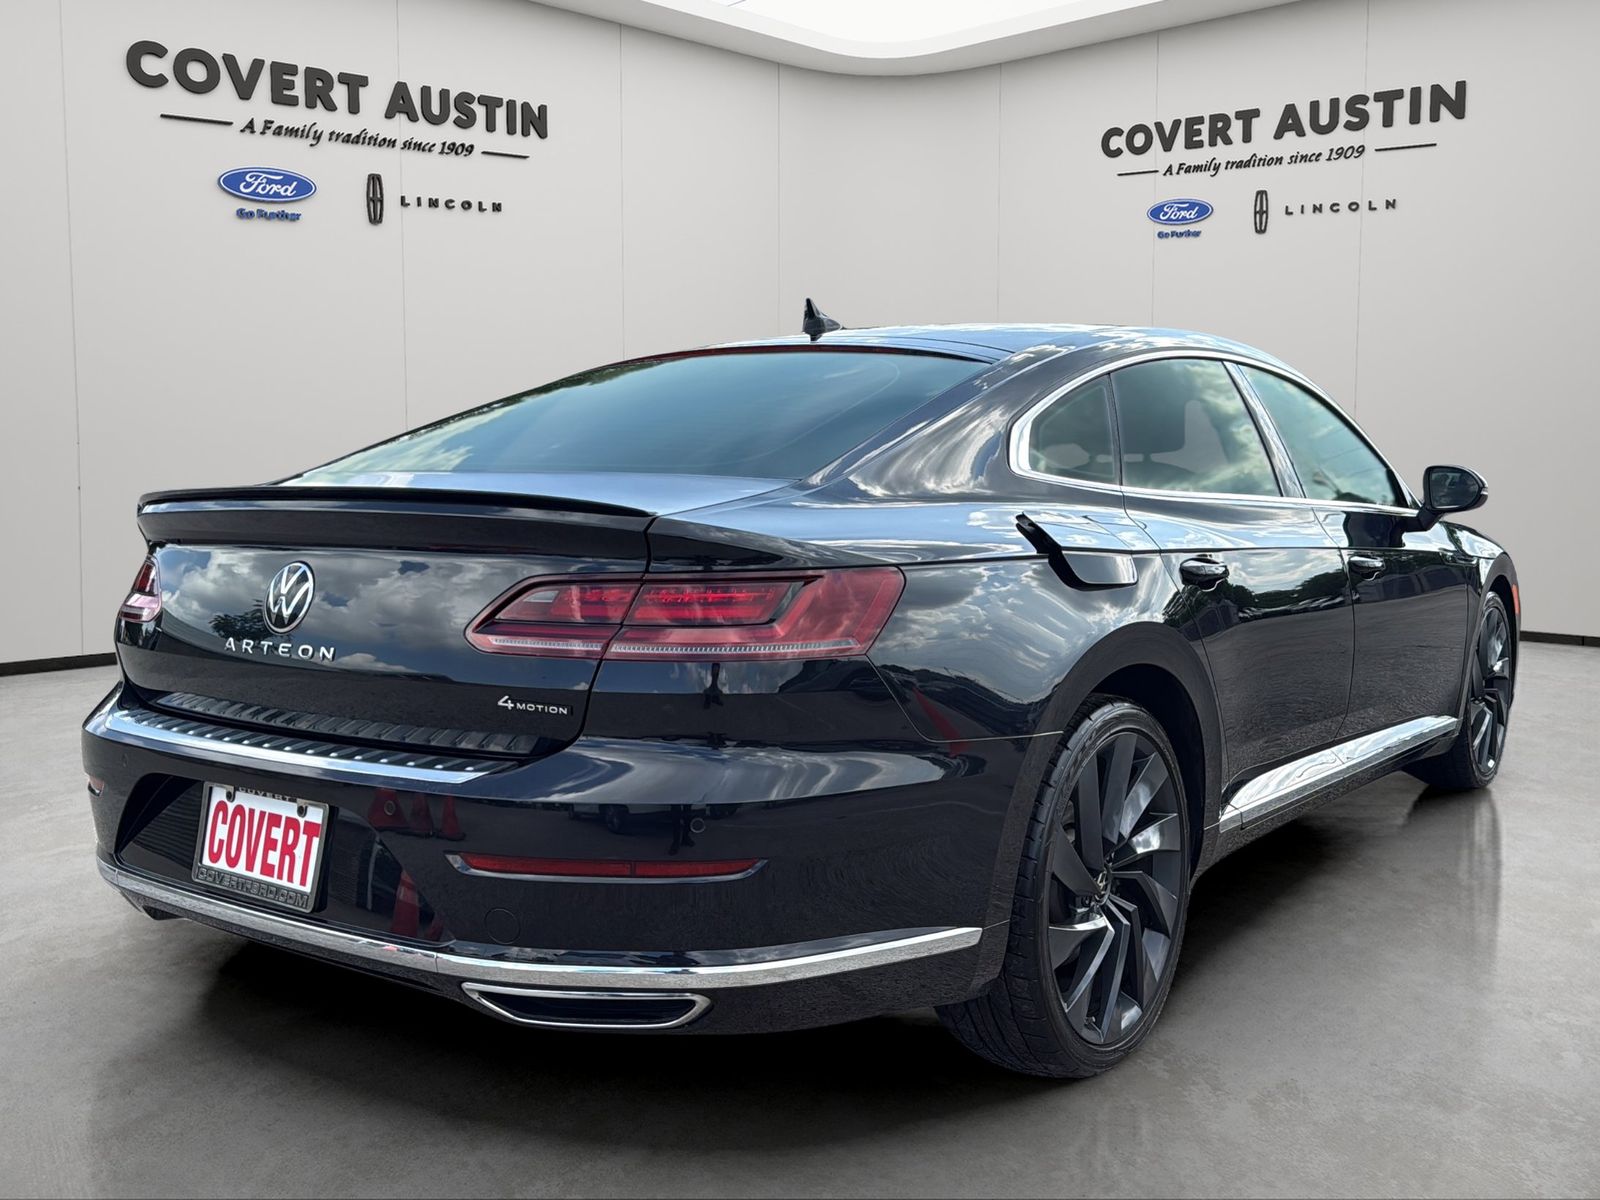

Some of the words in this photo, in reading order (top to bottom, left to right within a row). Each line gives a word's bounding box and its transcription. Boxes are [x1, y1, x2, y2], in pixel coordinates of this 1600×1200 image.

[126, 40, 368, 114] COVERT
[384, 80, 549, 139] AUSTIN
[1100, 108, 1261, 159] COVERT
[1273, 80, 1467, 140] AUSTIN
[240, 118, 256, 134] A
[260, 119, 324, 147] Family
[328, 128, 397, 149] tradition
[400, 137, 437, 154] since
[439, 140, 475, 157] 1909
[1163, 164, 1174, 176] A
[1176, 157, 1221, 177] Family
[1224, 153, 1283, 171] tradition
[1287, 151, 1323, 165] since
[1325, 144, 1366, 162] 1909
[239, 171, 298, 197] Ford
[400, 196, 503, 214] LINCOLN
[1160, 202, 1199, 220] Ford
[1285, 198, 1397, 216] LINCOLN
[224, 636, 336, 662] ARTEON
[208, 800, 322, 887] COVERT
